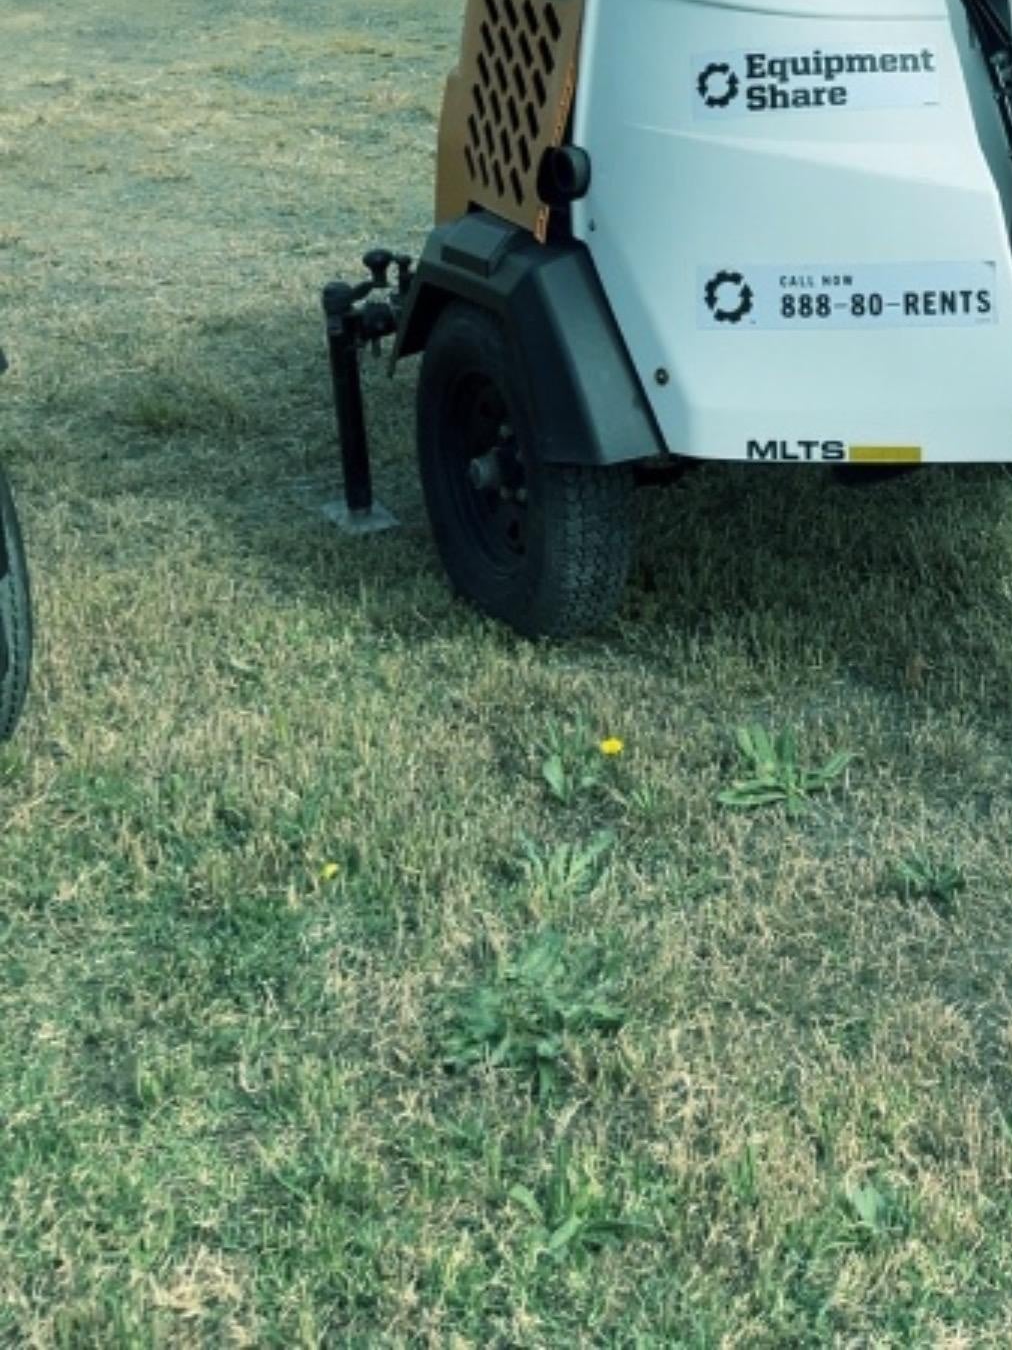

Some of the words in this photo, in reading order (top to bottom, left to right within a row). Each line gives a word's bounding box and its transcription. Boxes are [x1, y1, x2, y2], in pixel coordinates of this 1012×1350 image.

[744, 48, 936, 83] Equipment
[744, 83, 848, 111] Share
[779, 274, 815, 287] CALL
[821, 274, 854, 286] NOW
[780, 289, 992, 319] 888-80-RENTS
[746, 439, 846, 461] MLTS
